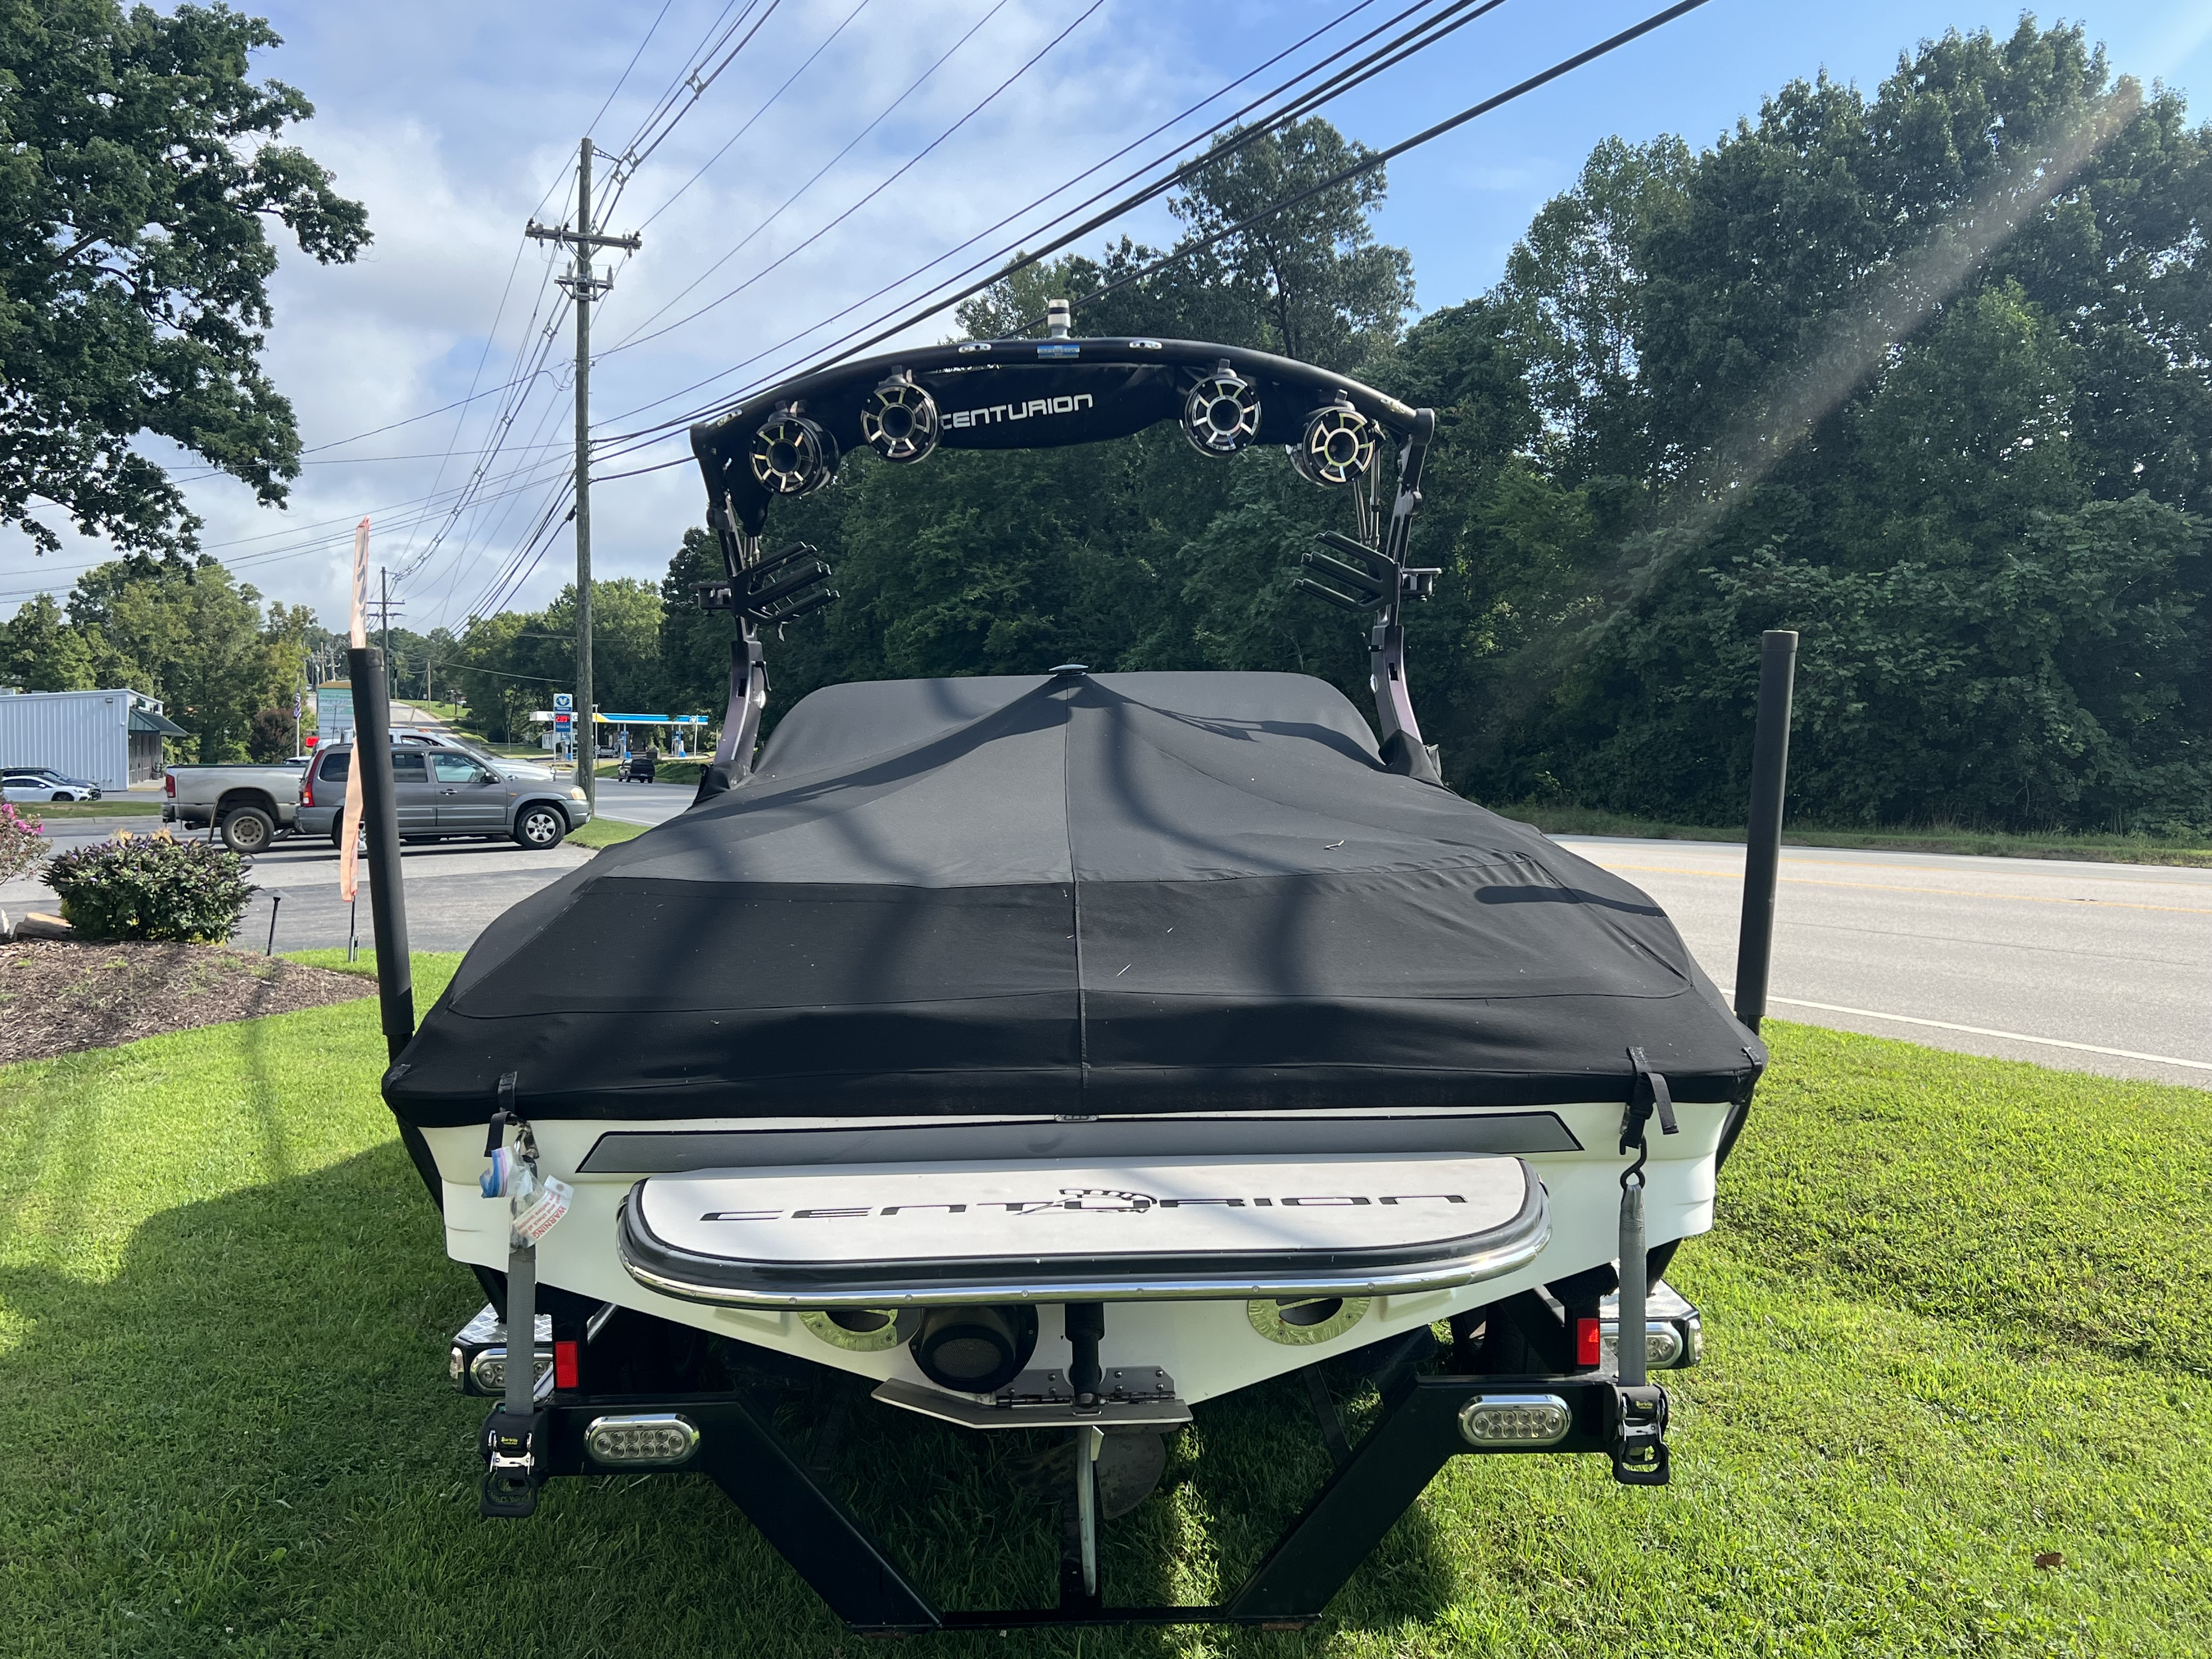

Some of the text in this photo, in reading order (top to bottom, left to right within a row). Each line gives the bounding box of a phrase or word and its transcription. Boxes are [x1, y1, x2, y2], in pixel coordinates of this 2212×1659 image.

[940, 393, 1093, 430] CENTURION
[532, 1206, 567, 1239] WARNING
[535, 1201, 550, 1216] before
[699, 1195, 1468, 1221] CENTURION
